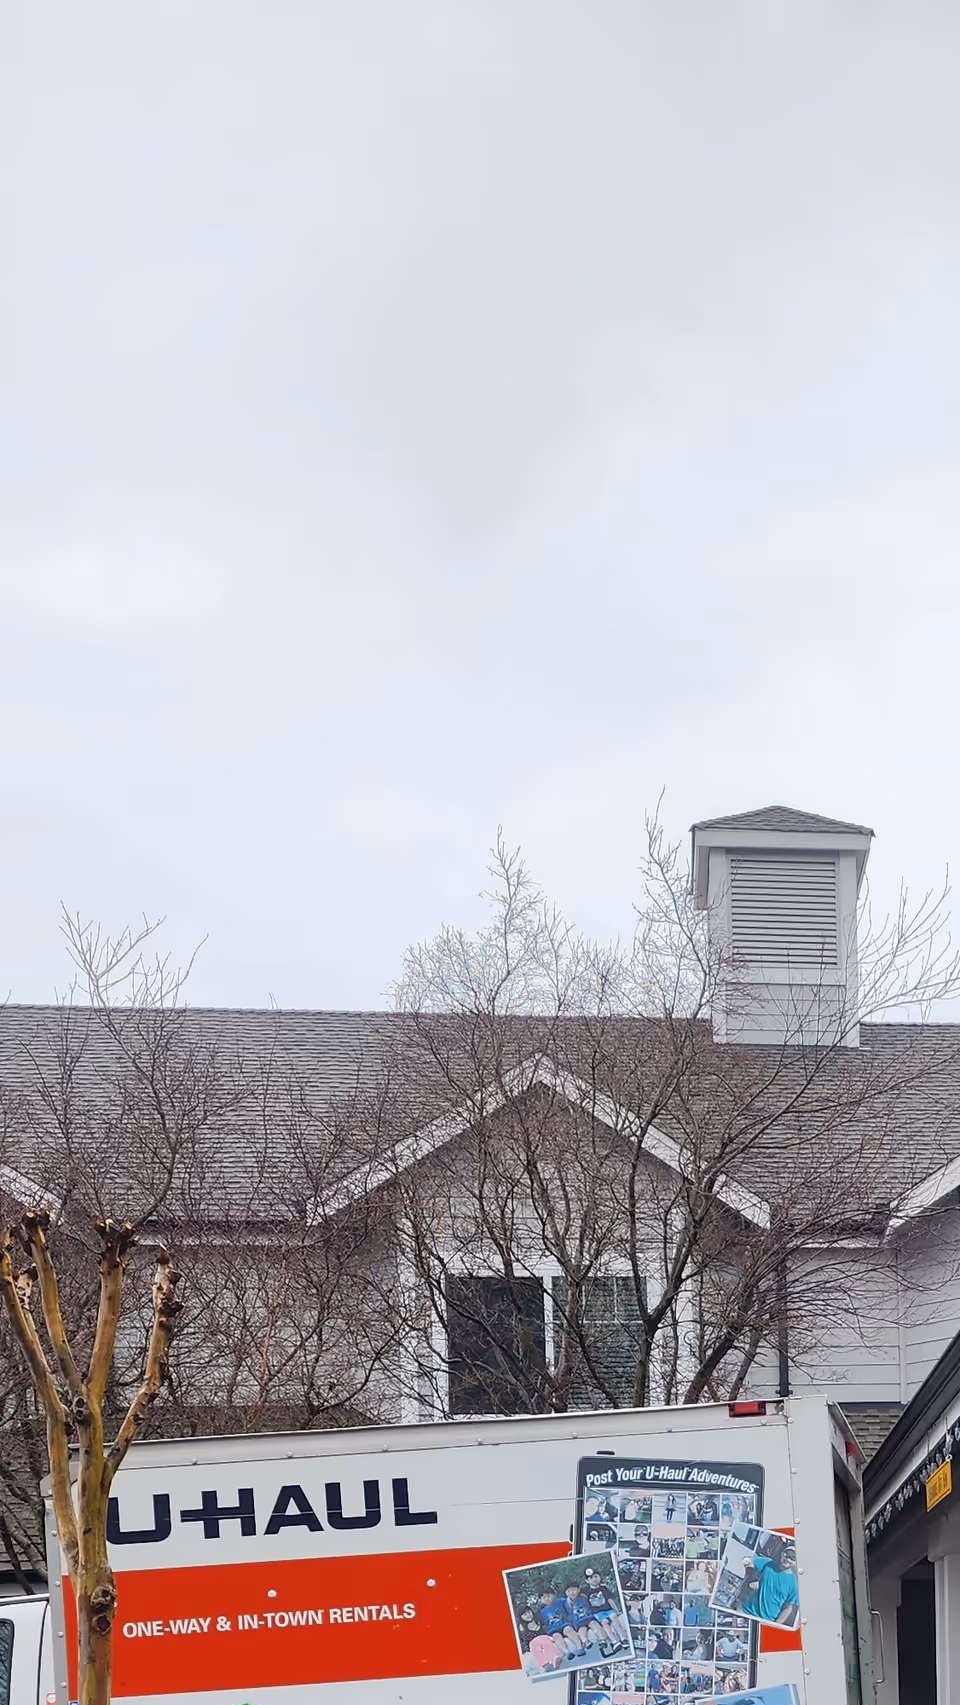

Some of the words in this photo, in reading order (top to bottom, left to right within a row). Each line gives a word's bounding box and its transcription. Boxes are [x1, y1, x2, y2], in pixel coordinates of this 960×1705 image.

[586, 1470, 613, 1487] Post
[616, 1467, 643, 1482] Your
[645, 1465, 687, 1480] U-Haul
[689, 1470, 756, 1493] Adventures
[106, 1477, 438, 1545] U-HAUL
[122, 1616, 212, 1638] ONE-WAY
[216, 1615, 231, 1631] &
[237, 1609, 324, 1630] IN-TOWN
[329, 1603, 416, 1624] RENTALS
